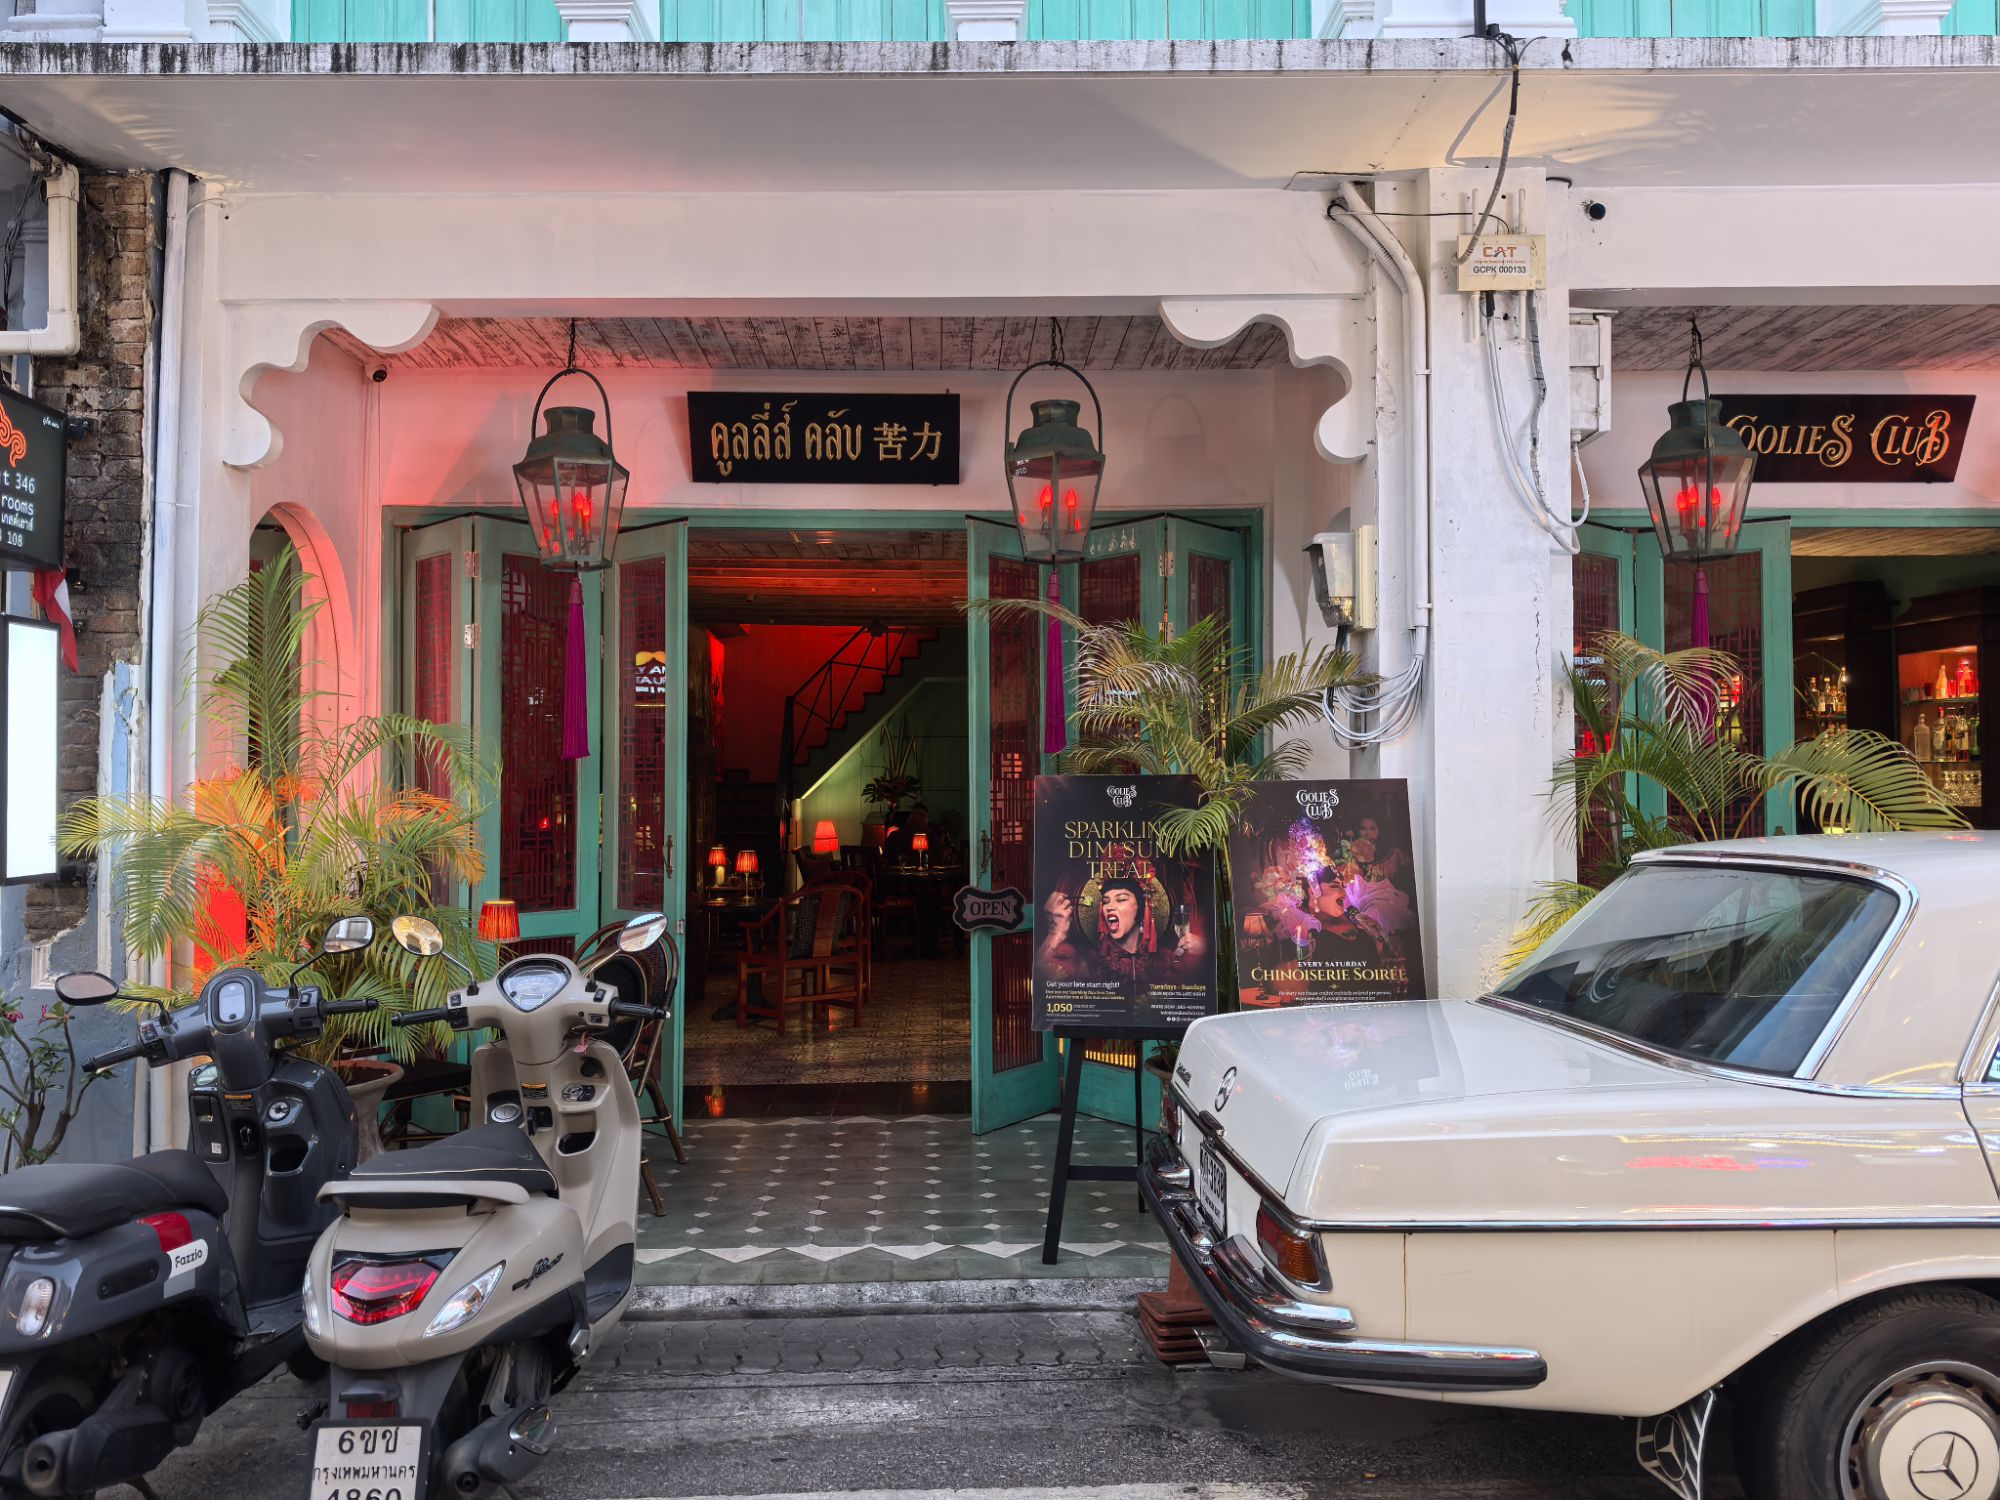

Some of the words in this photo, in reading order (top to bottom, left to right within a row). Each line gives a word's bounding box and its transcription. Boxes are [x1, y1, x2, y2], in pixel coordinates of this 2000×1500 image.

[1483, 247, 1517, 257] CAT
[1473, 266, 1497, 274] GCPK
[1499, 266, 1527, 274] 000133
[711, 400, 797, 477] คูลลี่ส์
[805, 408, 862, 461] คลับ
[873, 421, 943, 462] 苦力
[1870, 410, 1951, 467] CLUB
[15, 473, 35, 494] 346
[1, 494, 34, 516] rooms
[7, 531, 23, 547] 108
[1106, 785, 1137, 798] COOLIES
[1296, 789, 1339, 806] COOLIES
[1306, 803, 1333, 819] CLUB
[1065, 821, 1172, 839] SPARKLIN
[1069, 841, 1112, 858] DIM
[1086, 862, 1152, 879] TREAT
[970, 901, 1012, 916] OPEN
[1251, 967, 1351, 981] CHINOISERIE
[1046, 1003, 1073, 1013] 1,050
[175, 1249, 203, 1268] Fazzio
[338, 1427, 399, 1454] 6ขช
[313, 1465, 416, 1485] กรุงเทพมหานคร
